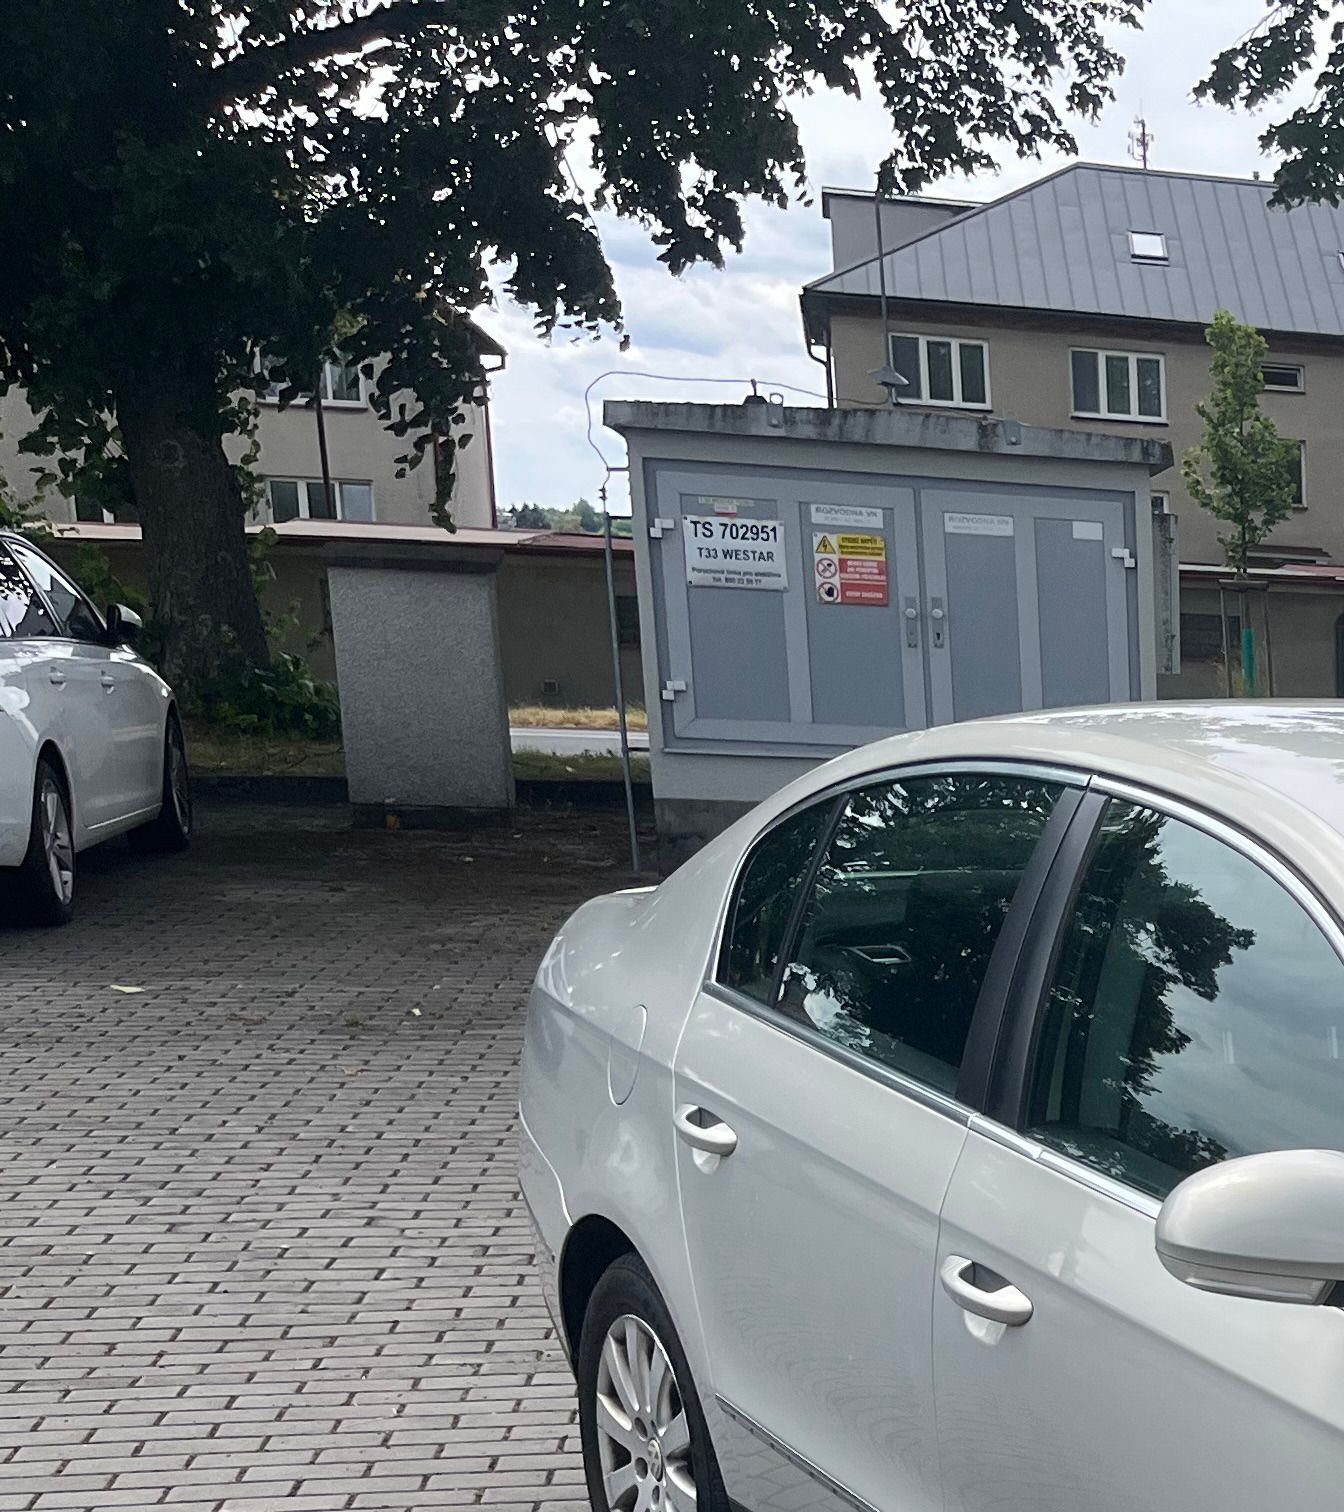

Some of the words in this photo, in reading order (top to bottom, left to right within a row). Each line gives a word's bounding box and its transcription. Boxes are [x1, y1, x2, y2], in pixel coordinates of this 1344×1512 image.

[690, 520, 714, 538] TS
[719, 522, 778, 543] 702951
[697, 547, 718, 559] T33
[722, 549, 775, 562] WESTAR
